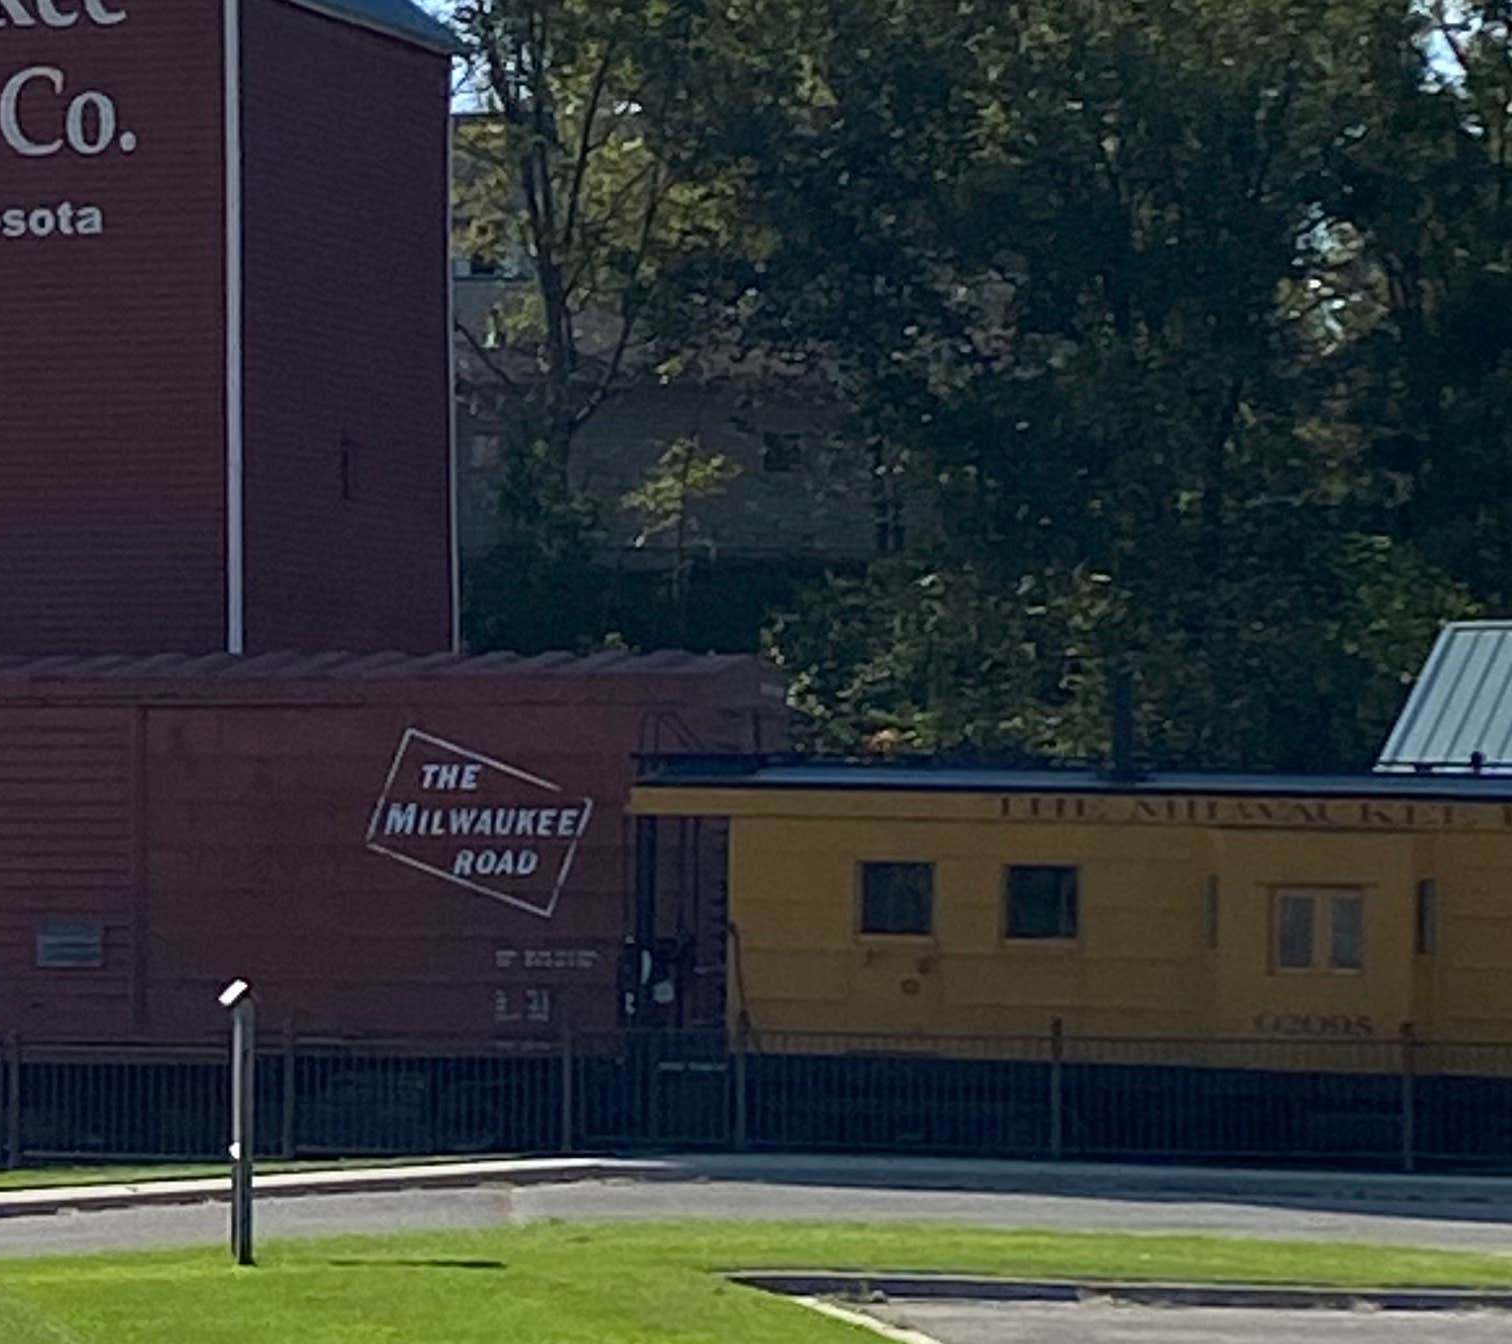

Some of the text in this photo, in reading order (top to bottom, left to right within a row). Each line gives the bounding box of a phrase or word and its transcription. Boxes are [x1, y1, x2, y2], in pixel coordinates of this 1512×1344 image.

[421, 763, 482, 790] THE
[384, 803, 579, 836] MILWAUKEE
[997, 796, 1106, 819] THE
[453, 849, 539, 876] ROAD
